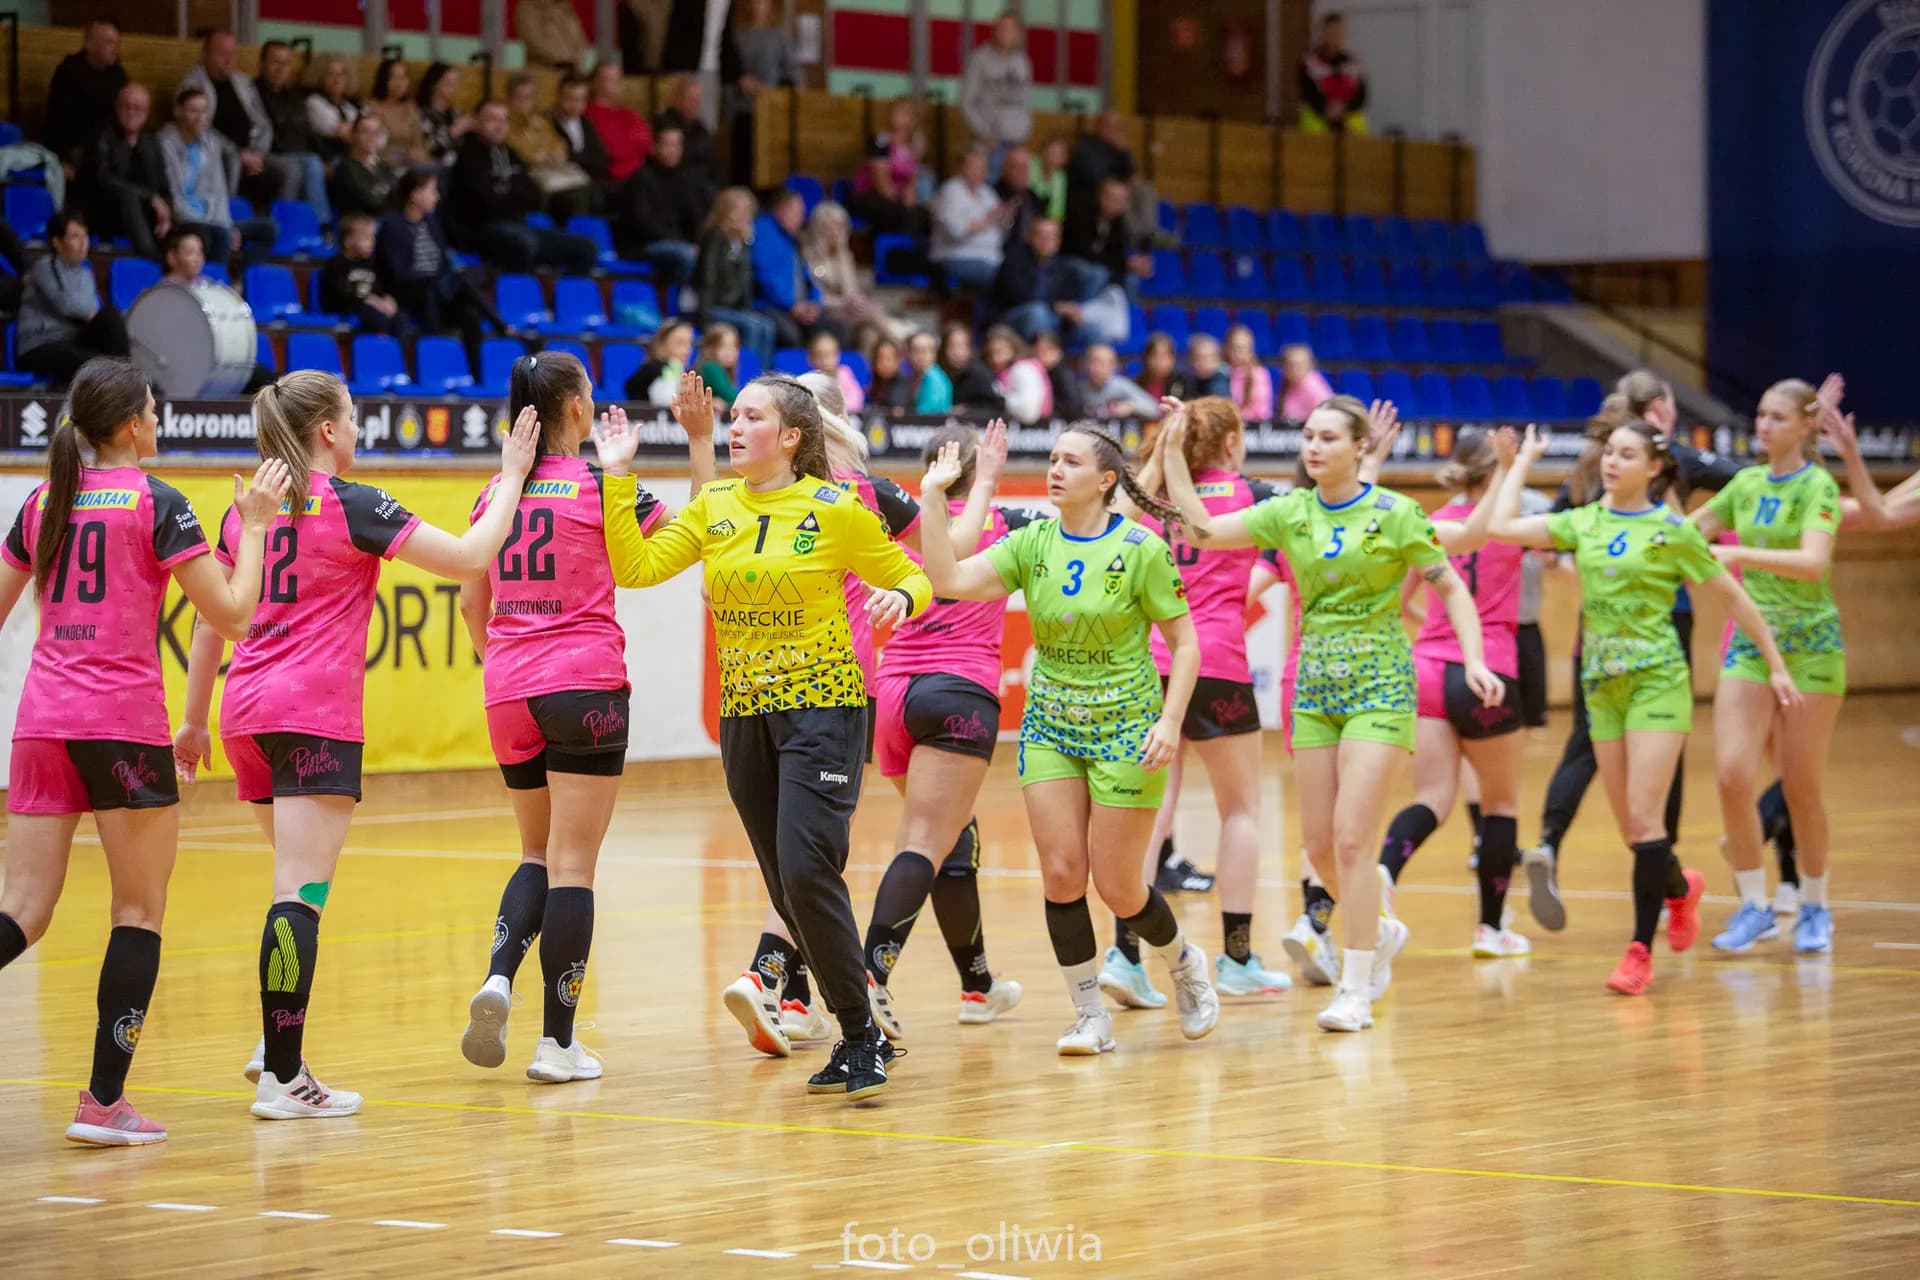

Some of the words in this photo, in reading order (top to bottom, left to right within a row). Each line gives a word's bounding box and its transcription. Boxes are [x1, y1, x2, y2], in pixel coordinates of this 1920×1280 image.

[498, 508, 556, 581] 22
[754, 515, 771, 554] 1
[1323, 526, 1345, 558] 5
[1607, 529, 1628, 558] 6
[51, 521, 106, 604] 79
[1062, 560, 1085, 596] 3
[495, 597, 562, 616] RUSZCZYŃSKA
[713, 609, 805, 627] MARECKIE
[1039, 645, 1118, 666] MARECKIE
[820, 770, 848, 785] Kempa
